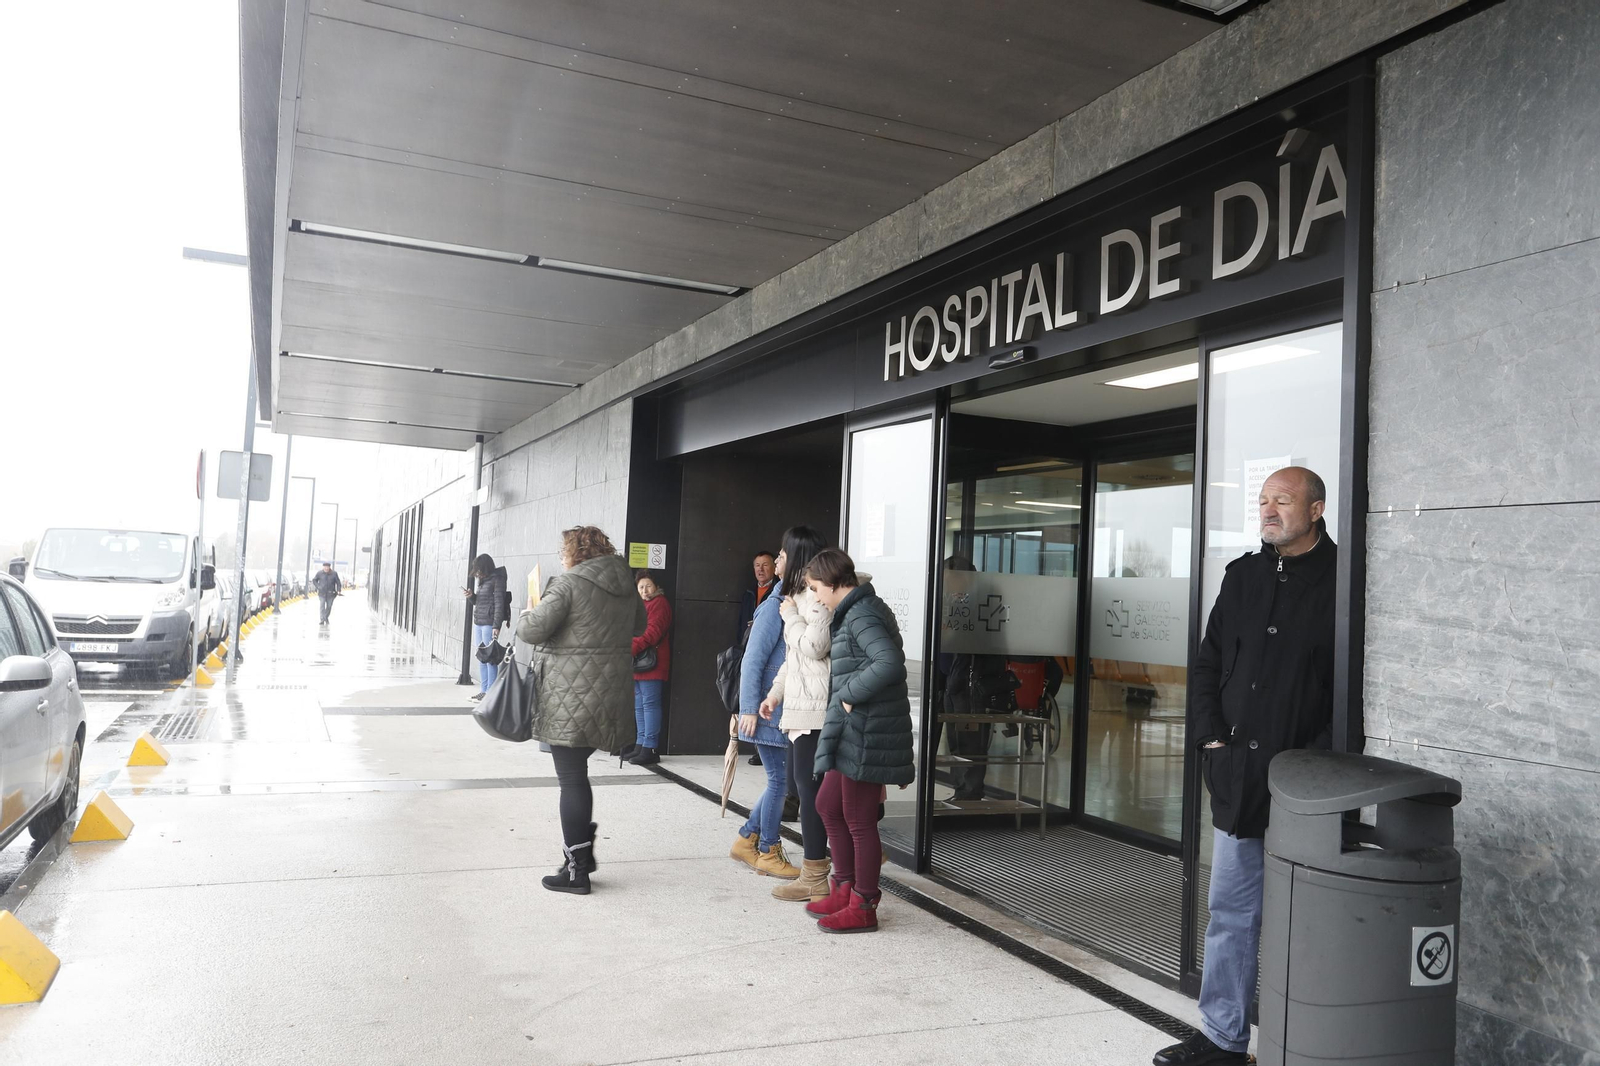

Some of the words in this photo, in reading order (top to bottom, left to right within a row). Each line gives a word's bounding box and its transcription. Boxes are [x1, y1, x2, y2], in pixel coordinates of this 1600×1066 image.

[884, 252, 1080, 381] HOSPITAL
[1100, 205, 1182, 315] DE
[1212, 128, 1347, 280] DÍA
[1130, 627, 1140, 639] de
